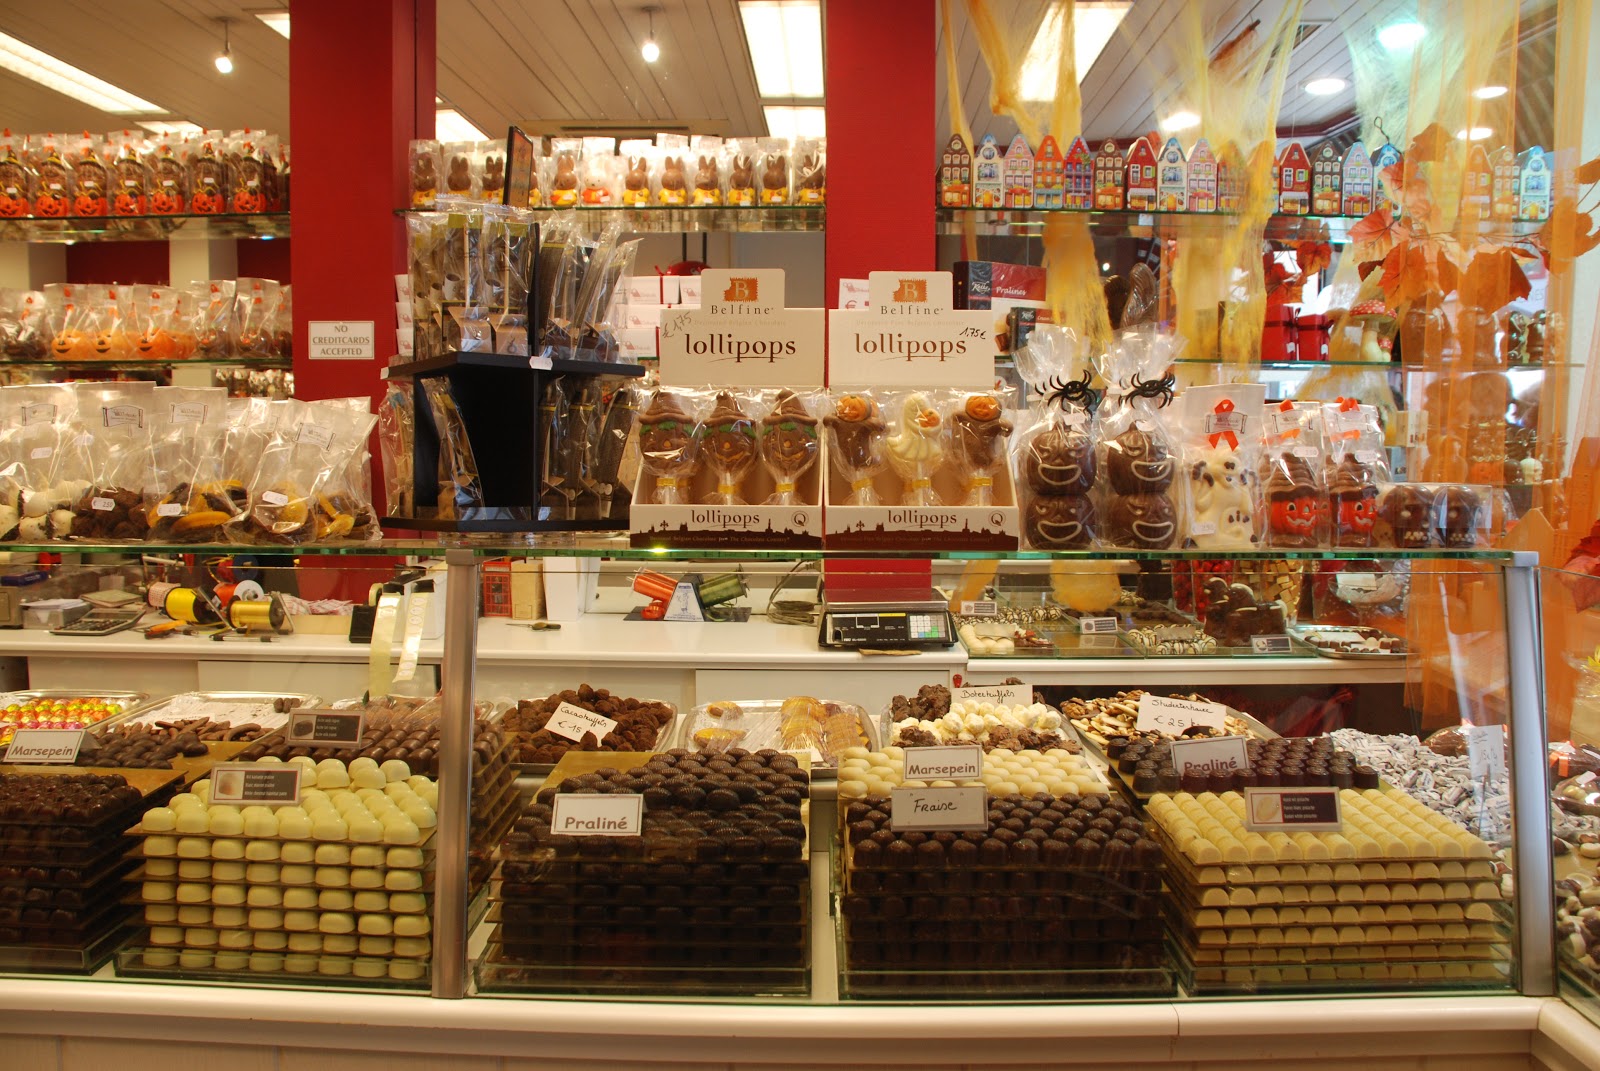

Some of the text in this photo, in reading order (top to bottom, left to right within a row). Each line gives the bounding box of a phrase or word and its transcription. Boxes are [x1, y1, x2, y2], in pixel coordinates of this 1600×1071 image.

[734, 280, 749, 300] B
[903, 282, 918, 300] B
[996, 285, 1027, 296] Pralines
[710, 303, 770, 315] Belfine
[880, 304, 940, 315] Belfine
[334, 325, 348, 333] NO
[312, 336, 370, 344] CREDITCARDS
[854, 332, 967, 362] lollipops
[320, 347, 363, 355] ACCEPTED
[684, 333, 796, 363] lollipops
[691, 510, 760, 528] lollipops
[888, 510, 957, 528] lollipops
[11, 745, 73, 759] Marsepein
[908, 763, 976, 777] Marsepein
[1184, 756, 1238, 772] Praliné
[913, 798, 958, 813] Fraise
[564, 816, 628, 830] Praliné
